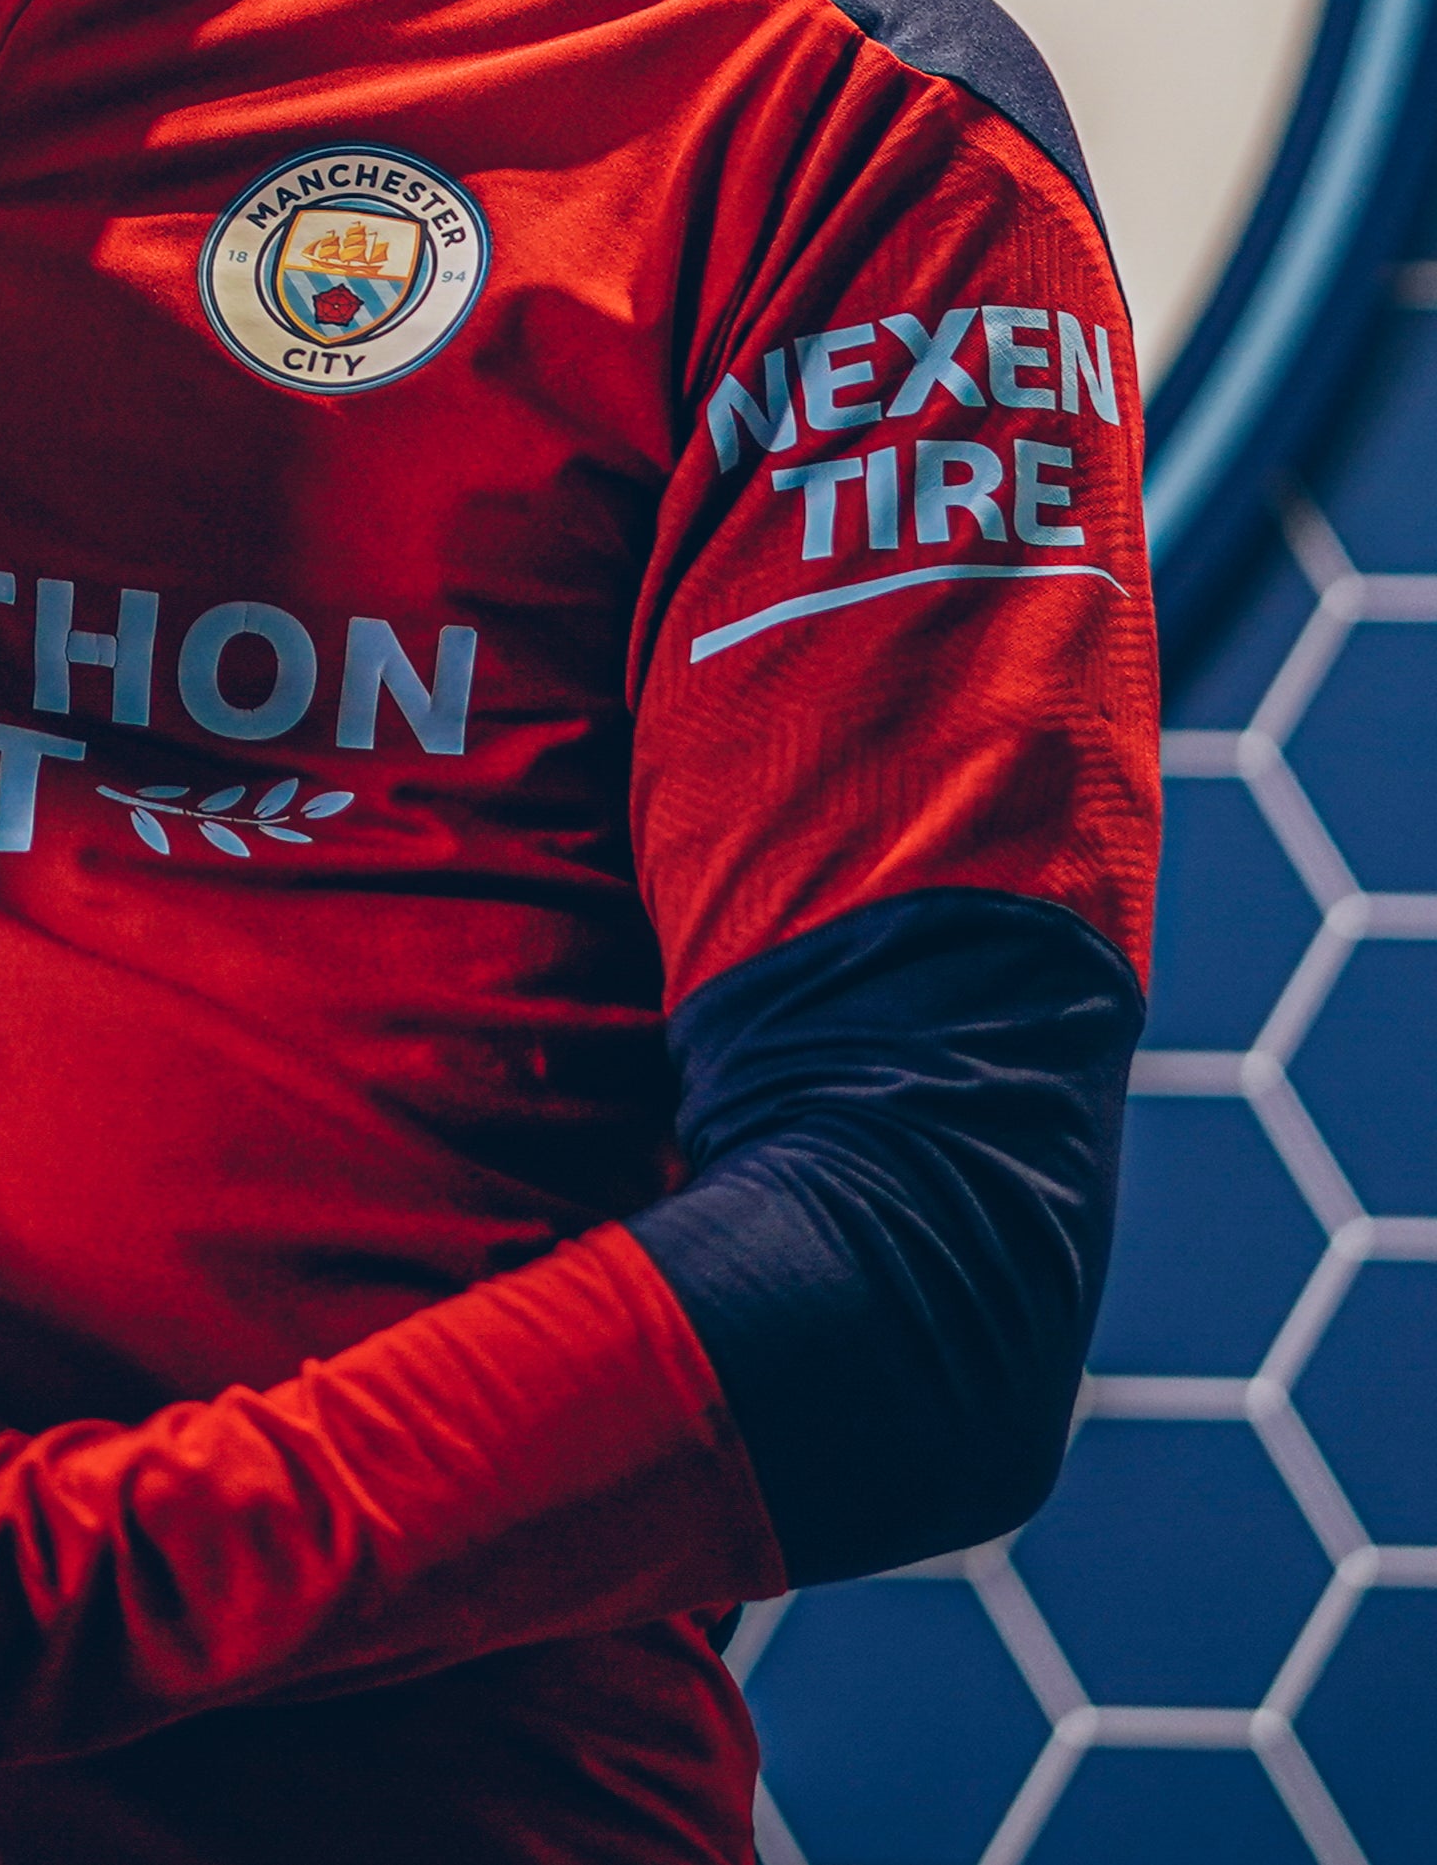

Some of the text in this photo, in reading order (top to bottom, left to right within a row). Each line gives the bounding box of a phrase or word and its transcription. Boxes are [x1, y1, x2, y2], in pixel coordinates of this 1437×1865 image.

[246, 163, 467, 248] MANCHESTER
[228, 249, 248, 264] 18
[441, 270, 466, 284] 94
[282, 347, 366, 376] CITY
[706, 304, 1120, 474] NEXEN
[771, 438, 1085, 561] TIRE
